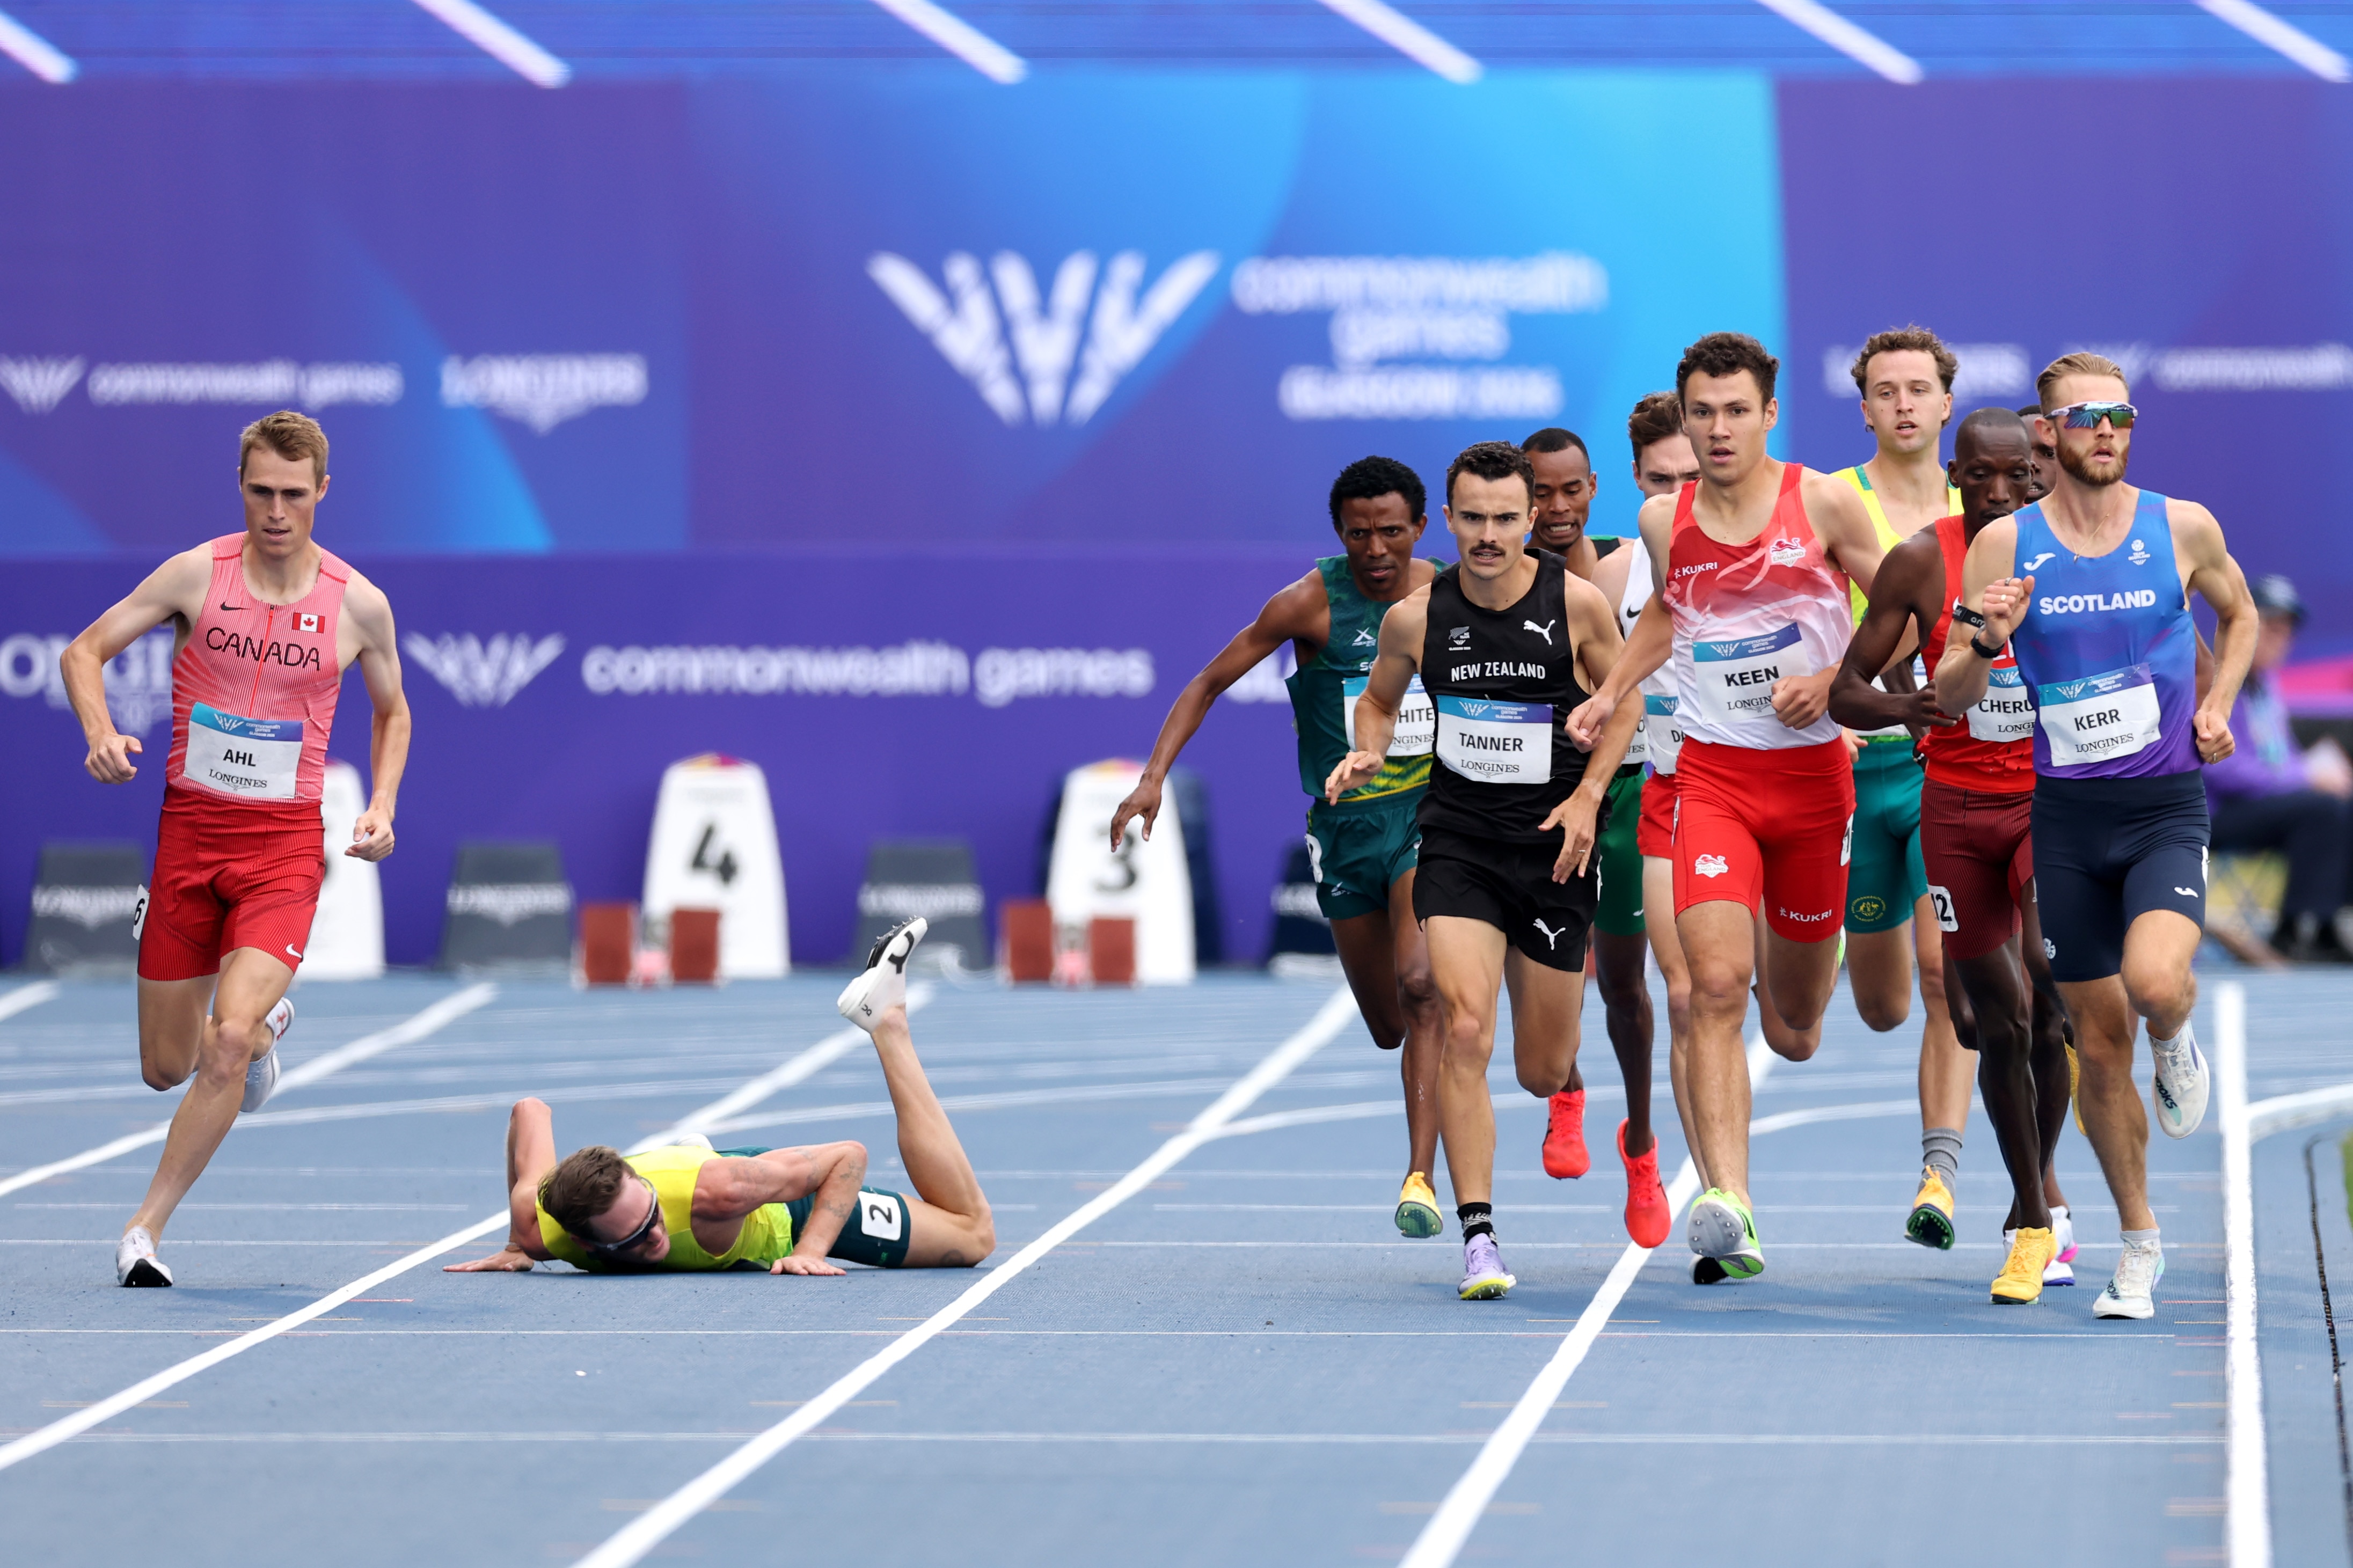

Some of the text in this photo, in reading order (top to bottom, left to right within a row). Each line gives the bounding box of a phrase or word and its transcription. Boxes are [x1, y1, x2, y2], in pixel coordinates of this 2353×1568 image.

[1232, 252, 1609, 314] commonwealth
[1328, 309, 1511, 373] games
[87, 358, 405, 412] commonwealth games
[1773, 552, 1804, 561] ENGLAND
[1682, 562, 1718, 576] KUKRI
[2040, 589, 2156, 616] SCOTLAND
[206, 627, 320, 671] CANADA
[1741, 635, 1778, 646] commonwealth
[581, 639, 970, 697] commonwealth
[973, 646, 1157, 708] games
[1451, 662, 1546, 682] NEW ZEALAND
[1724, 666, 1779, 687] KEEN
[2088, 673, 2124, 686] commonwealth
[1727, 695, 1771, 710] LONGIN
[1978, 699, 2034, 713] CHERU
[1399, 707, 1434, 723] HITE
[2074, 709, 2121, 731] KERR
[1998, 722, 2035, 732] LONGI
[1393, 734, 1435, 745] NGINES
[1459, 732, 1523, 752] TANNER
[2075, 733, 2134, 752] LONGINES
[223, 749, 256, 767] AHL
[1460, 759, 1520, 773] LONGINES
[209, 769, 267, 788] LONGINES
[690, 824, 738, 885] 4
[1095, 824, 1137, 893] 3
[134, 898, 145, 926] 6
[1789, 909, 1832, 922] KUKRI
[1931, 893, 1953, 922] 12
[2155, 1077, 2177, 1109] OOKS
[869, 1204, 892, 1224] 2
